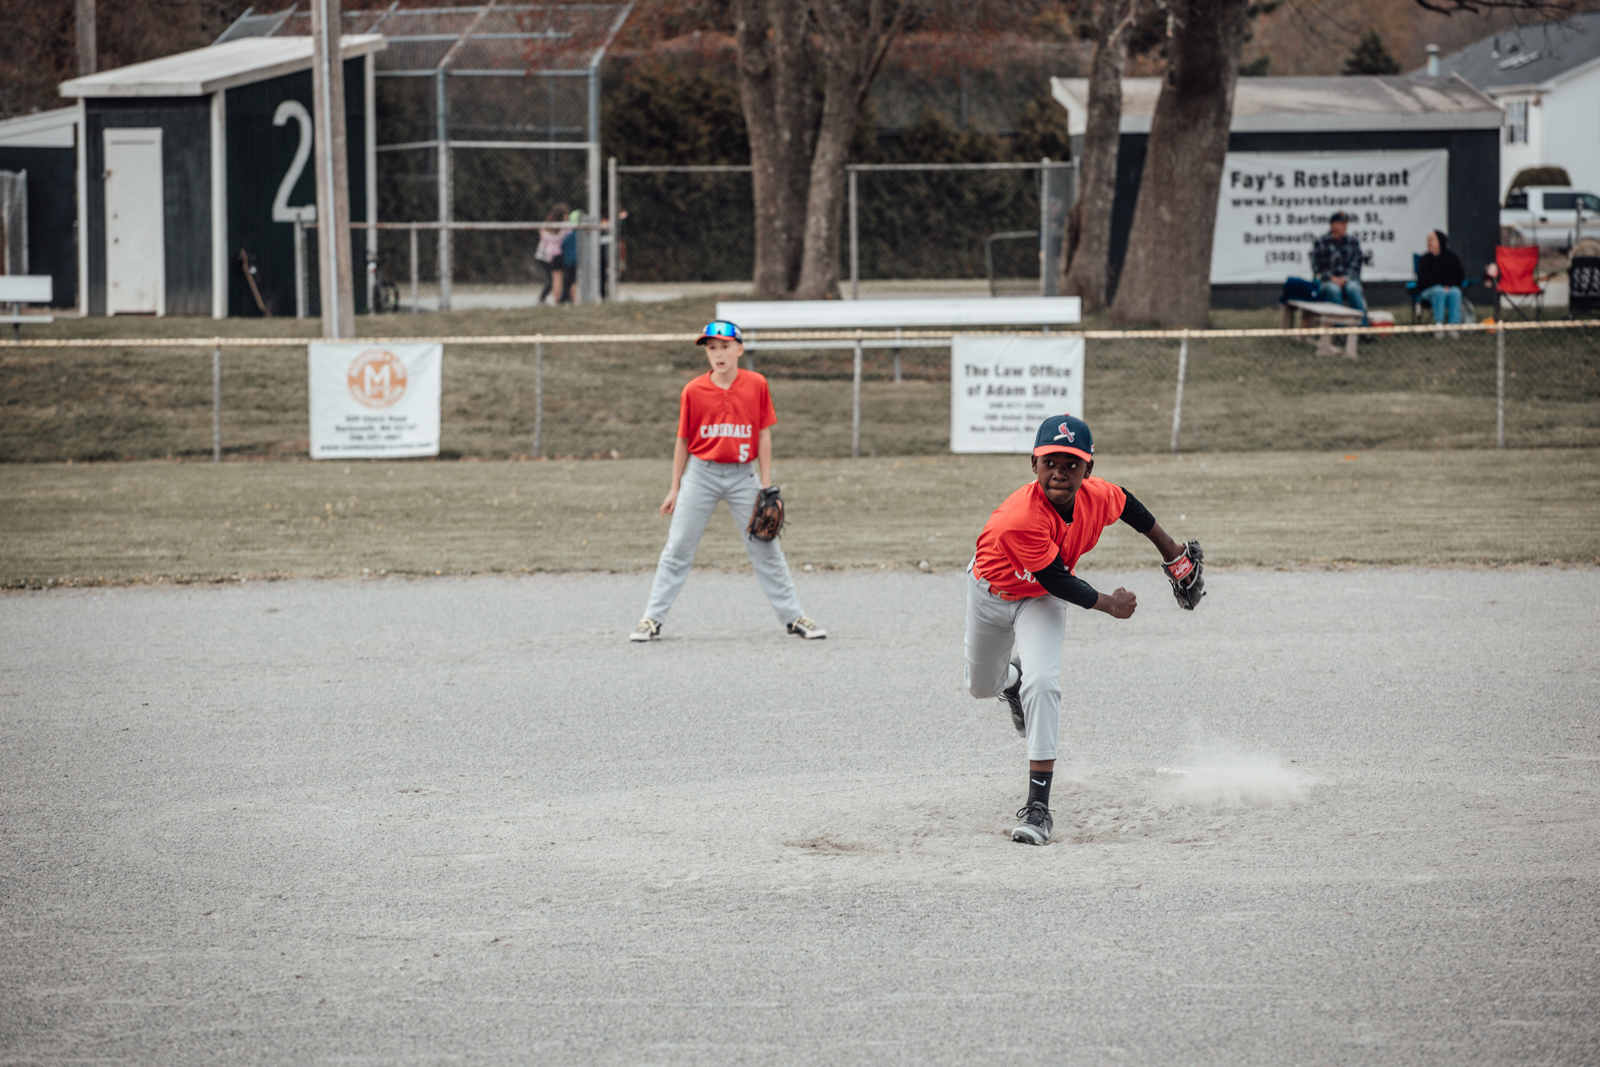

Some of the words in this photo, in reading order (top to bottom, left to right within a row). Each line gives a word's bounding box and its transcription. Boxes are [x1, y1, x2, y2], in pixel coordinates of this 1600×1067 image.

[271, 99, 317, 223] 2
[1230, 171, 1285, 192] Fay's
[1294, 169, 1410, 188] Restaurant
[1231, 193, 1409, 208] www.faysrestaurant.com
[1265, 251, 1302, 265] (508)
[964, 364, 988, 377] The
[994, 364, 1024, 377] Law
[1029, 364, 1072, 377] Office
[967, 384, 980, 397] of
[986, 384, 1026, 397] Adam
[1033, 384, 1068, 397] Silva
[700, 423, 752, 439] CARDINALS
[738, 443, 750, 462] 5
